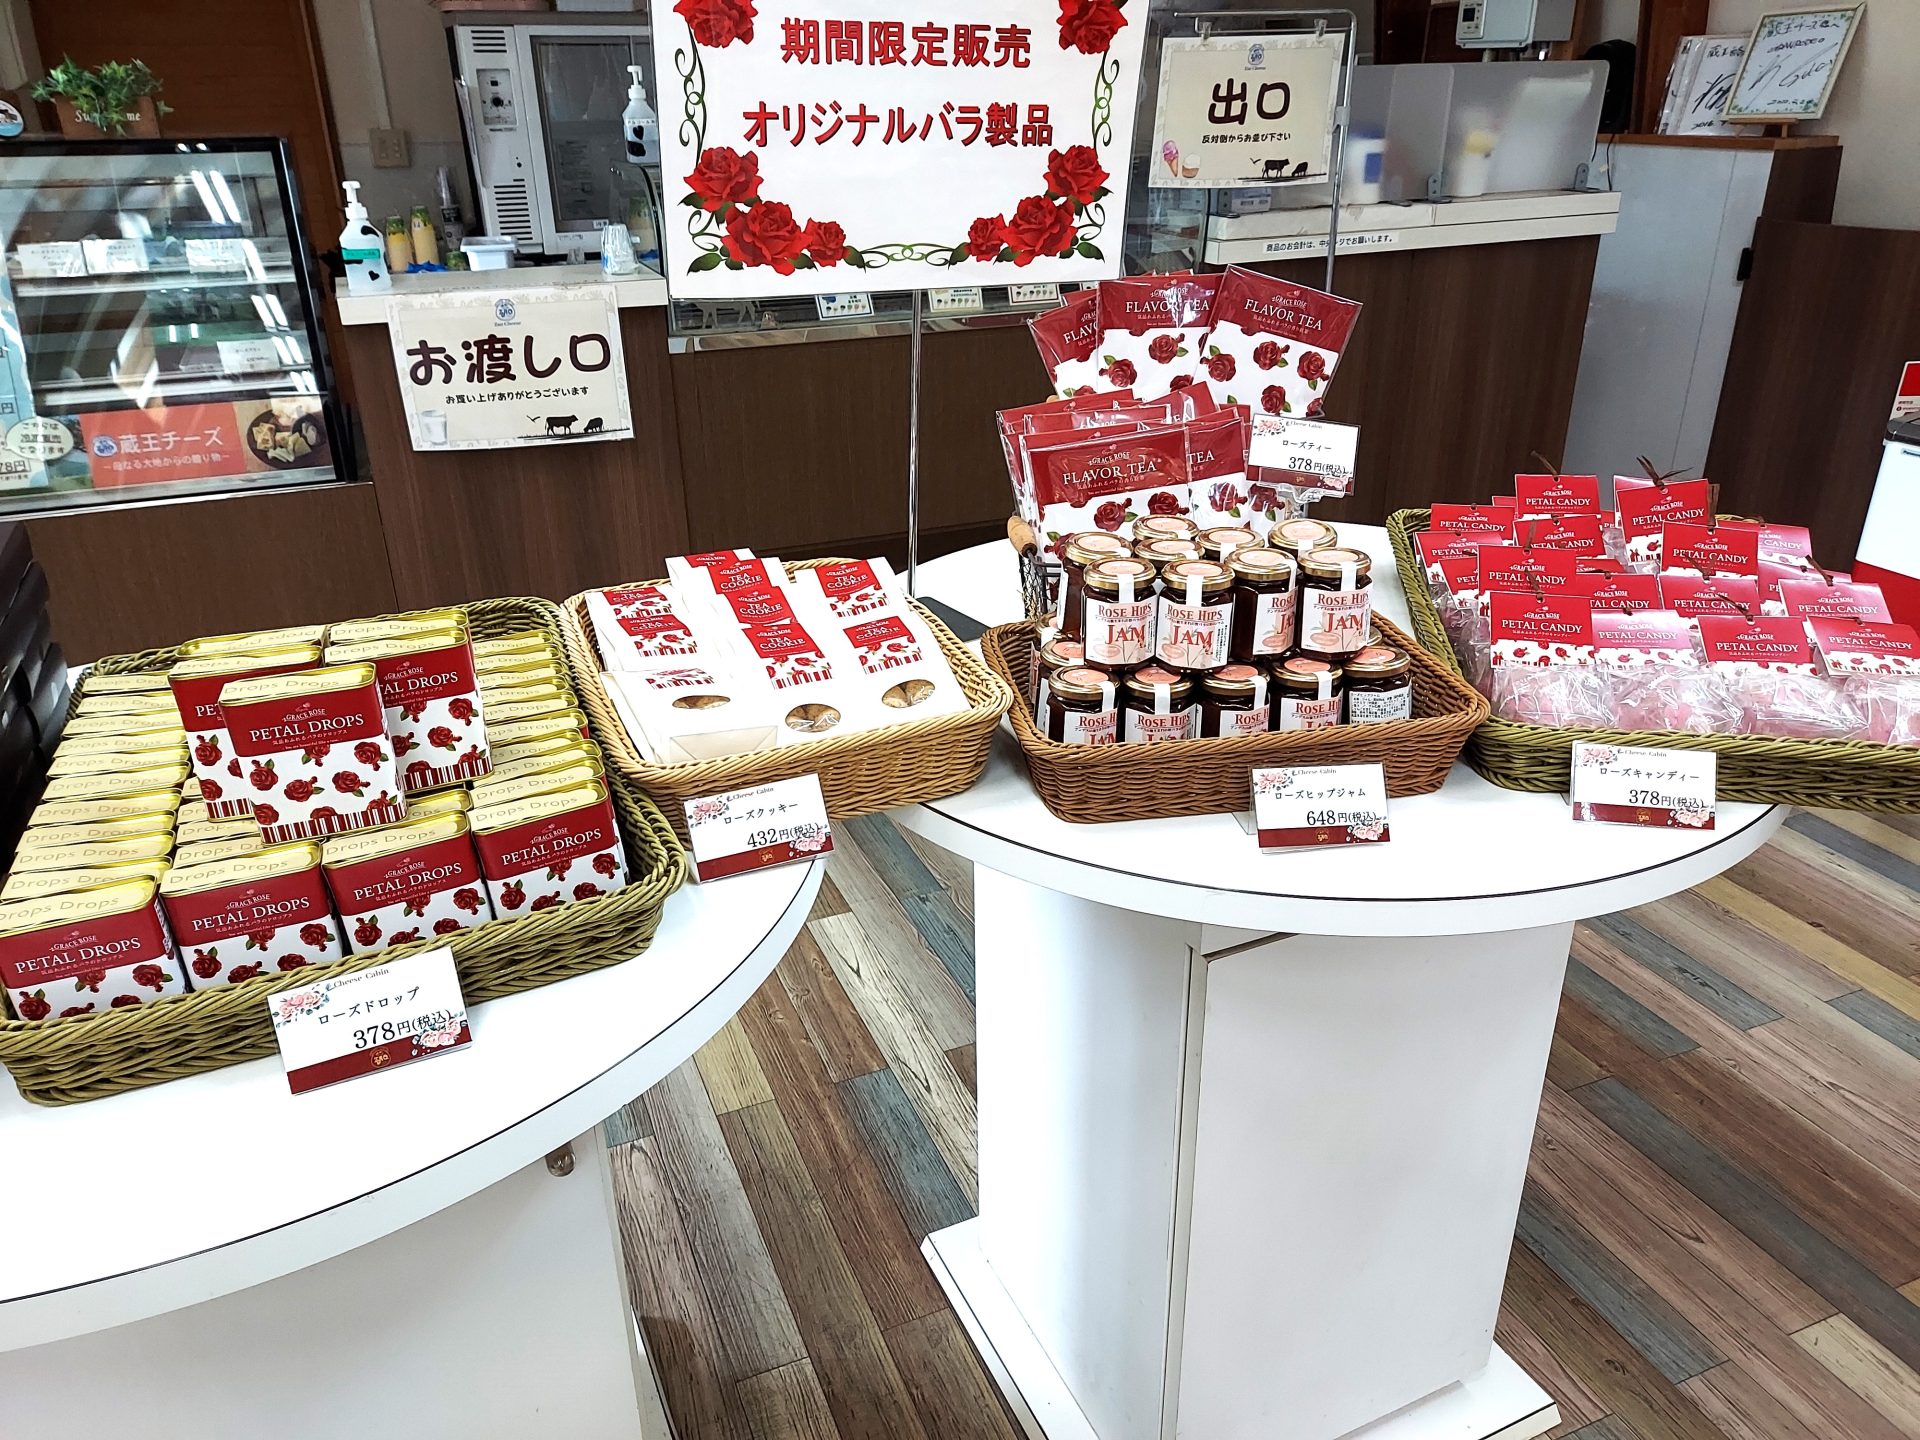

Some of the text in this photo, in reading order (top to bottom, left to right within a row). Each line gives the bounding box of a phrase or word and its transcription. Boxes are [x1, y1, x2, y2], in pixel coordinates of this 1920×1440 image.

[780, 17, 1032, 68] 期間限定販売
[1207, 78, 1290, 125] 出口
[742, 100, 1053, 147] オリジナルバラ製品
[1202, 132, 1291, 144] 反対側からお並び下さい
[1266, 235, 1393, 252] 商品のお会計は、中央ジでお願いします。
[1126, 301, 1182, 312] FLAVOR
[1275, 295, 1307, 308] GRACE ROSE
[1244, 299, 1322, 330] FLAVOR TEA
[407, 334, 611, 386] お渡し口
[446, 386, 589, 404] お買い上げありがとうございます
[118, 426, 223, 454] 蔵王チーズ
[1283, 440, 1332, 452] ローズティー
[1092, 451, 1130, 464] GRACE ROSE
[1186, 450, 1215, 464] TEA
[1289, 457, 1346, 474] 378円(税込)
[1062, 461, 1157, 485] FLAVOR TEA
[1632, 509, 1705, 526] PETAL CANDY
[1471, 523, 1505, 532] CANDY
[1673, 549, 1748, 564] PETAL CANDY
[721, 575, 763, 589] COOKIE
[827, 574, 868, 589] COOKIE
[1318, 593, 1347, 606] ROSE
[1590, 600, 1608, 608] TAL
[740, 603, 783, 615] COOKIE
[1098, 603, 1152, 617] ROSE HIPS
[1167, 604, 1194, 620] ROSE
[1199, 609, 1223, 621] HIPS
[1798, 605, 1835, 613] PETAL
[1323, 612, 1364, 632] JAM
[1502, 620, 1582, 633] PETAL CANDY
[1105, 624, 1146, 645] JAM
[1171, 625, 1214, 648] JAM
[1637, 632, 1678, 640] CANDY
[1829, 636, 1912, 650] PETAL CANDY
[760, 638, 805, 649] COOKIE
[1716, 643, 1798, 653] PETAL CANDY
[388, 666, 424, 680] GRACE ROSE
[407, 671, 458, 691] DROPS
[224, 674, 341, 694] Drops Drops
[286, 708, 326, 721] GRACE ROSE
[1296, 702, 1325, 714] ROSE
[249, 714, 364, 741] PETAL DROPS
[1079, 716, 1107, 727] ROSE
[1138, 712, 1190, 727] ROSE HIPS
[1235, 713, 1261, 725] ROSE
[1600, 767, 1700, 782] ローズキャンディー
[476, 774, 574, 800] Drops Drops
[1275, 788, 1366, 799] ローズヒップジャム
[1629, 789, 1707, 808] 378円(税込)
[475, 797, 578, 822] Drops Drops
[724, 802, 798, 824] ローズクッキー
[1306, 810, 1377, 825] 648円(税込)
[326, 830, 436, 856] Drops Drops
[534, 828, 568, 842] GRACE ROSE
[747, 823, 820, 848] 432円(税込)
[501, 828, 602, 866] PETAL DROPS
[19, 848, 140, 864] Drops Drops
[170, 860, 288, 884] Drops Drops
[388, 861, 426, 878] GRACE ROSE
[353, 862, 462, 900] PETAL DROPS
[60, 897, 119, 911] Drops
[229, 894, 270, 909] GRACE ROSE
[192, 896, 310, 931] PETAL DROPS
[53, 934, 98, 951] GRACE ROSE
[14, 937, 141, 974] PETAL DROPS
[333, 967, 390, 989] Cheese Cabin
[318, 986, 420, 1024] ローズドロップ
[353, 1009, 454, 1049] 378円(税込)
